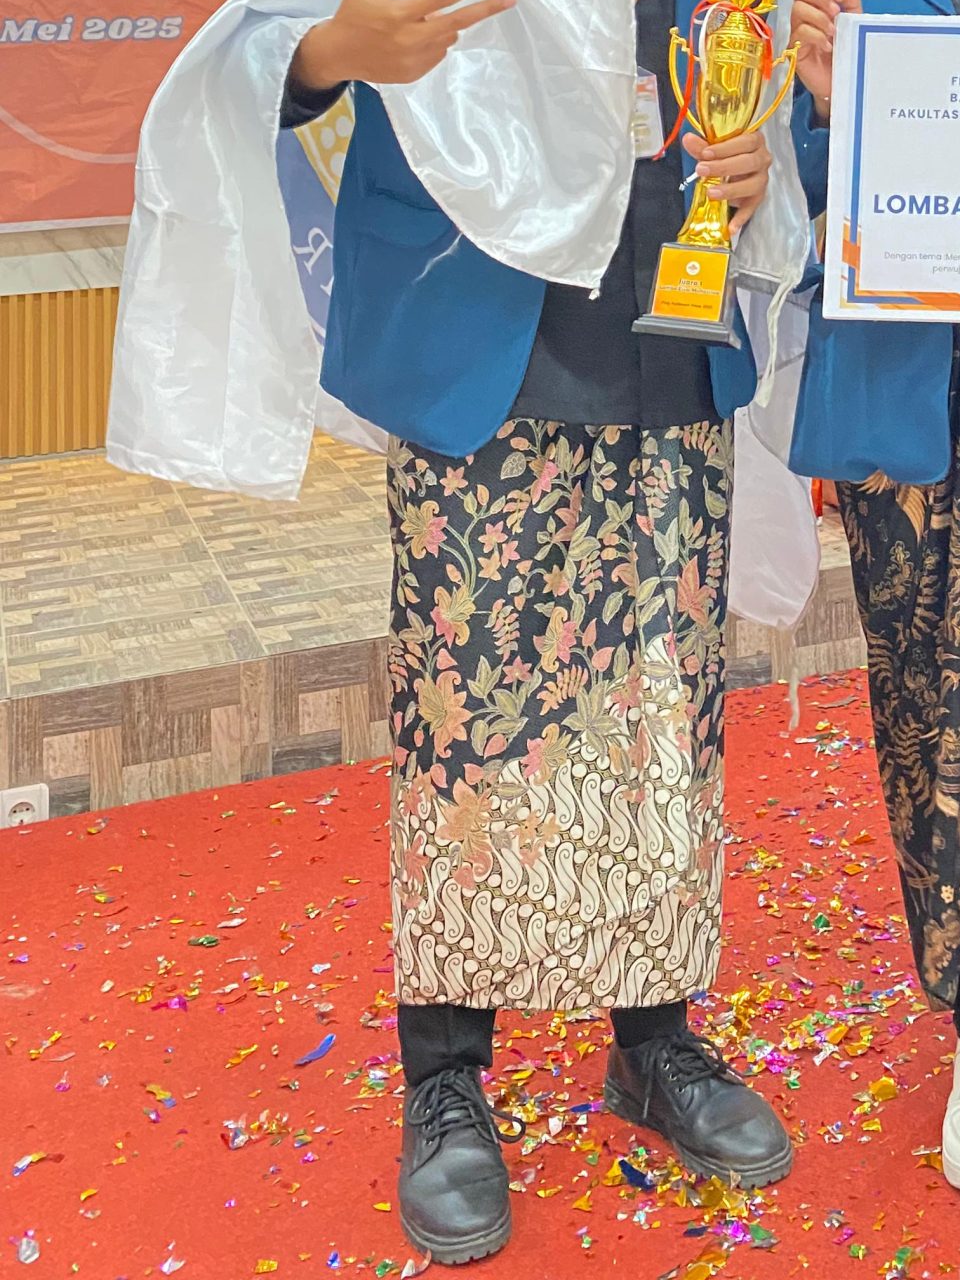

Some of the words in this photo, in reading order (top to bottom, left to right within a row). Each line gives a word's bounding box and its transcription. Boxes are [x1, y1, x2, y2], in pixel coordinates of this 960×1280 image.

[0, 16, 73, 43] Mei
[82, 16, 183, 40] 2025
[890, 108, 959, 119] FAKULTAS
[884, 251, 918, 261] Dengan
[919, 252, 942, 260] tema
